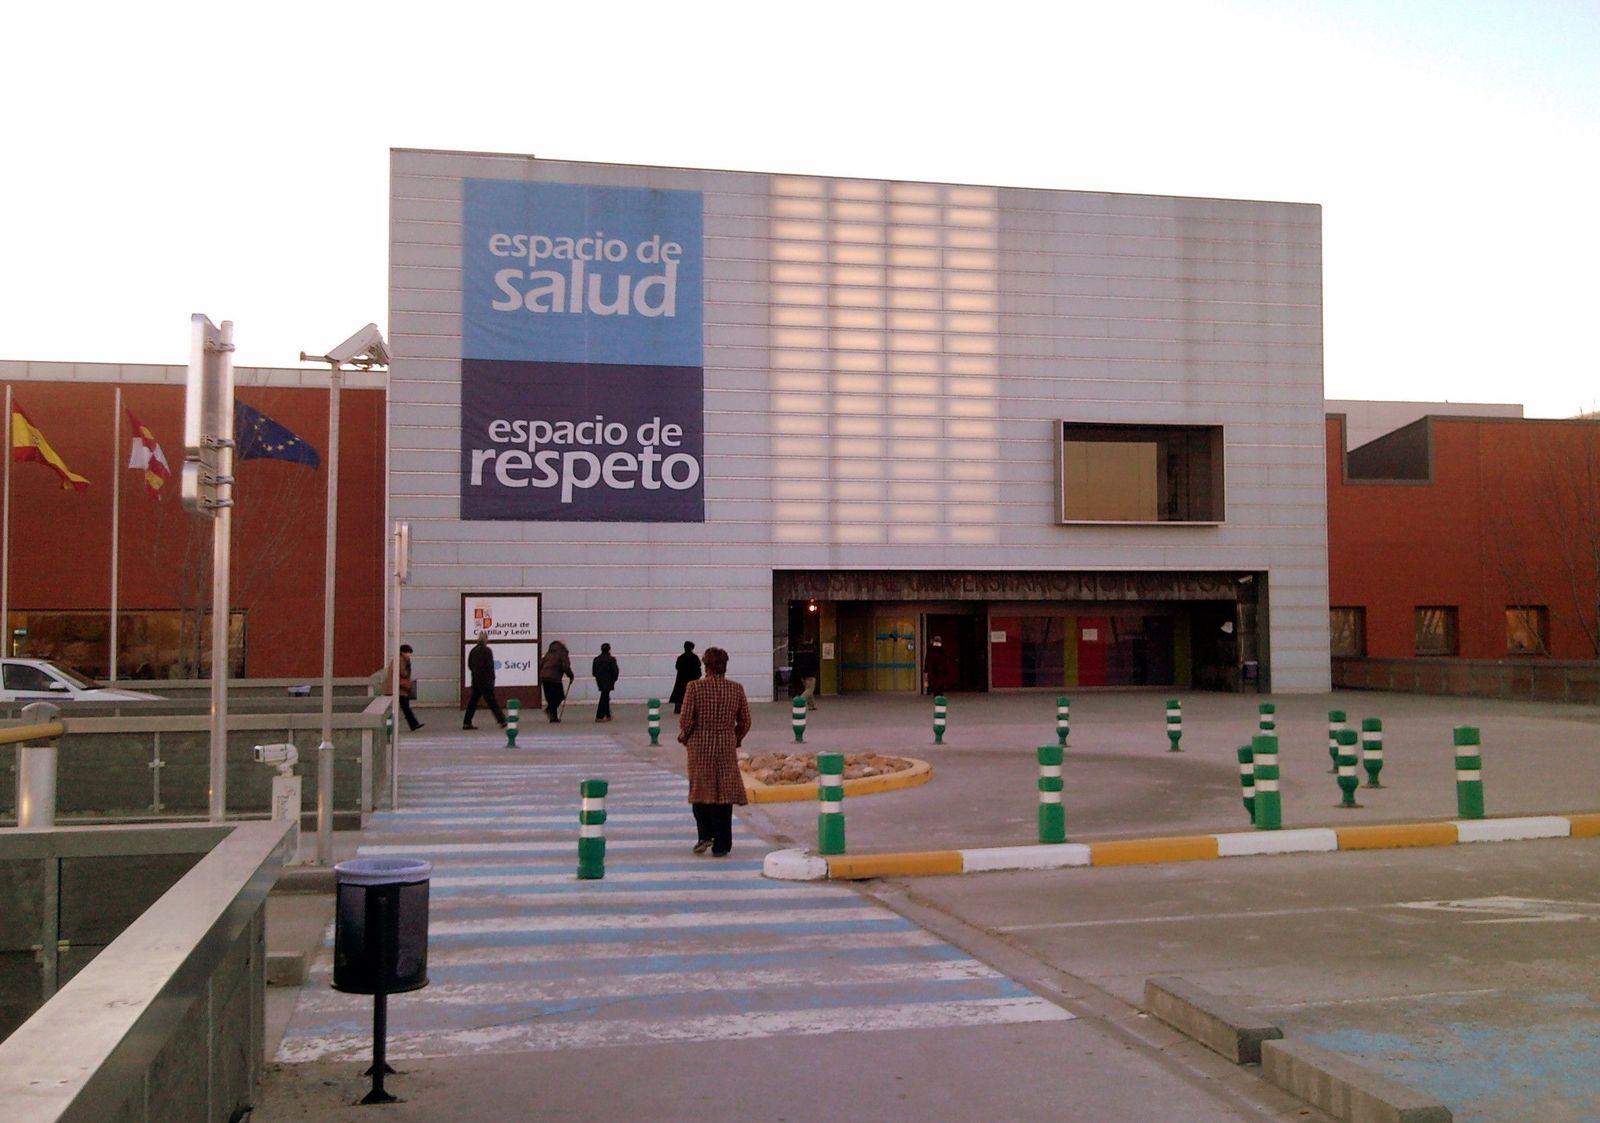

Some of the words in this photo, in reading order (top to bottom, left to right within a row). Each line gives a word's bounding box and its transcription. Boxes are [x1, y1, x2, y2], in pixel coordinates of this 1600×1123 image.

[489, 232, 628, 267] espacio
[636, 235, 683, 265] de
[492, 259, 678, 318] salud
[488, 415, 628, 452] espacio
[637, 417, 683, 447] de
[470, 446, 700, 503] respeto
[495, 621, 517, 629] Junta
[504, 660, 531, 671] Sacyl
